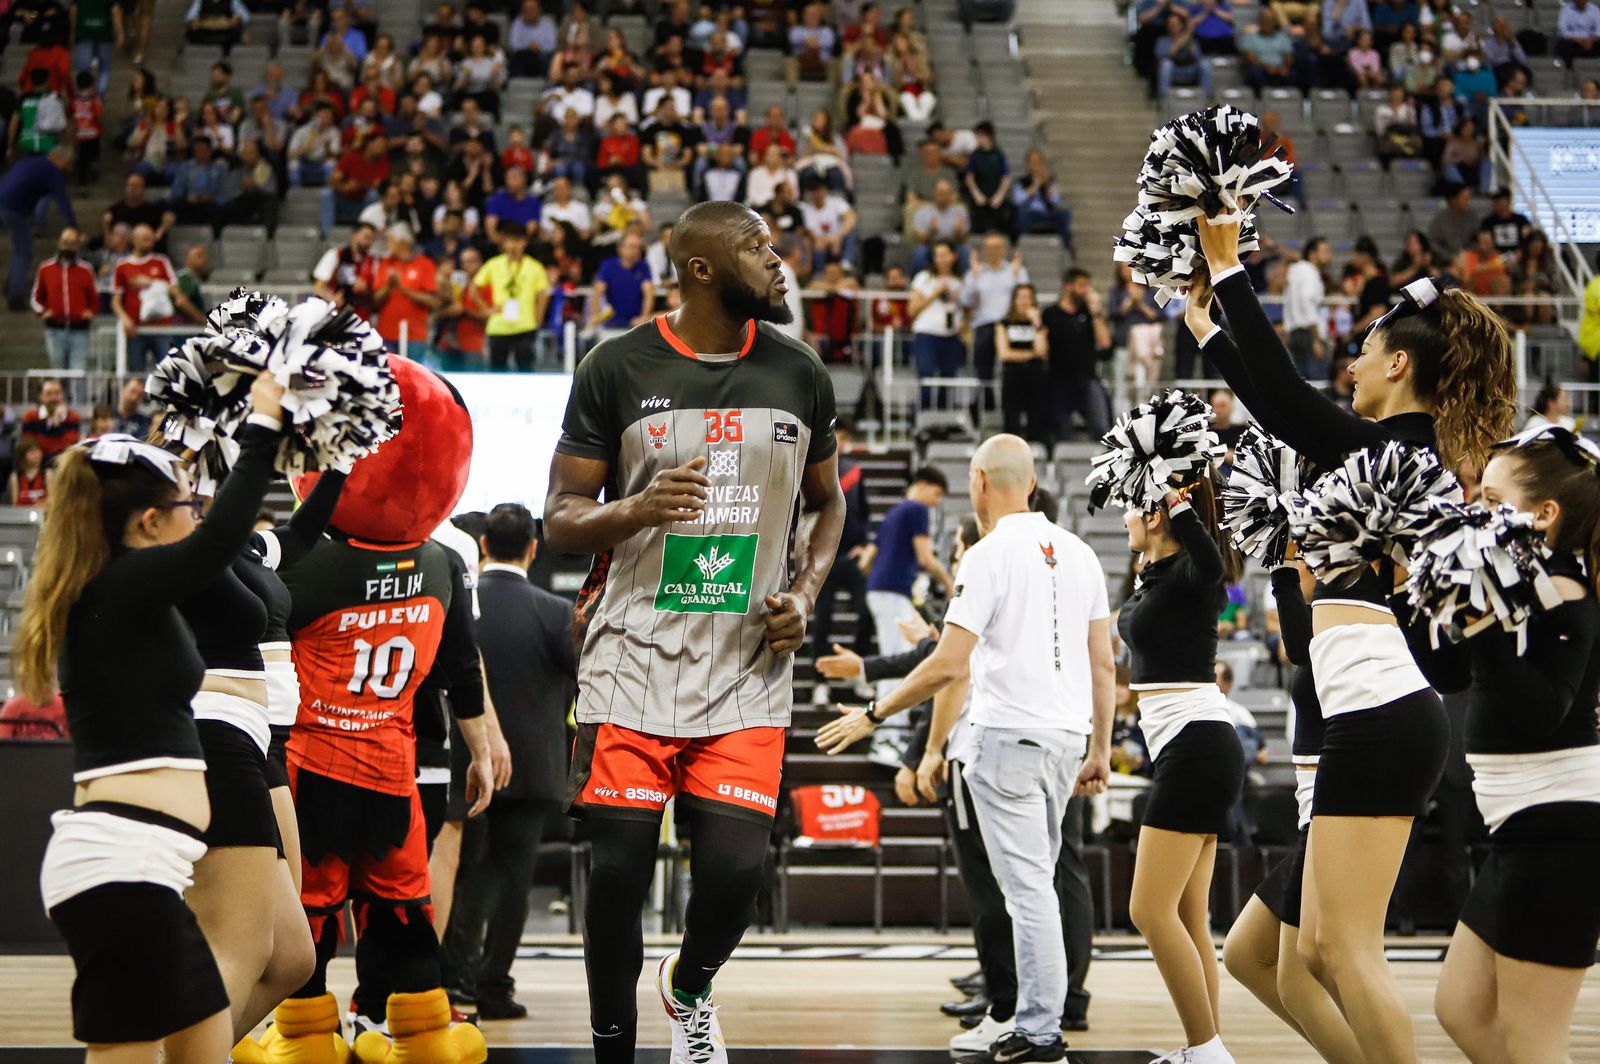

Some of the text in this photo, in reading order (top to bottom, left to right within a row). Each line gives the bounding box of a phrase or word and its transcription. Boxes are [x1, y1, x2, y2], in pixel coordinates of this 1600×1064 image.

[703, 411, 744, 444] 35
[703, 485, 759, 503] RVEZAS
[664, 583, 697, 595] CAJA
[338, 604, 430, 632] PULEVA
[346, 635, 416, 700] 10
